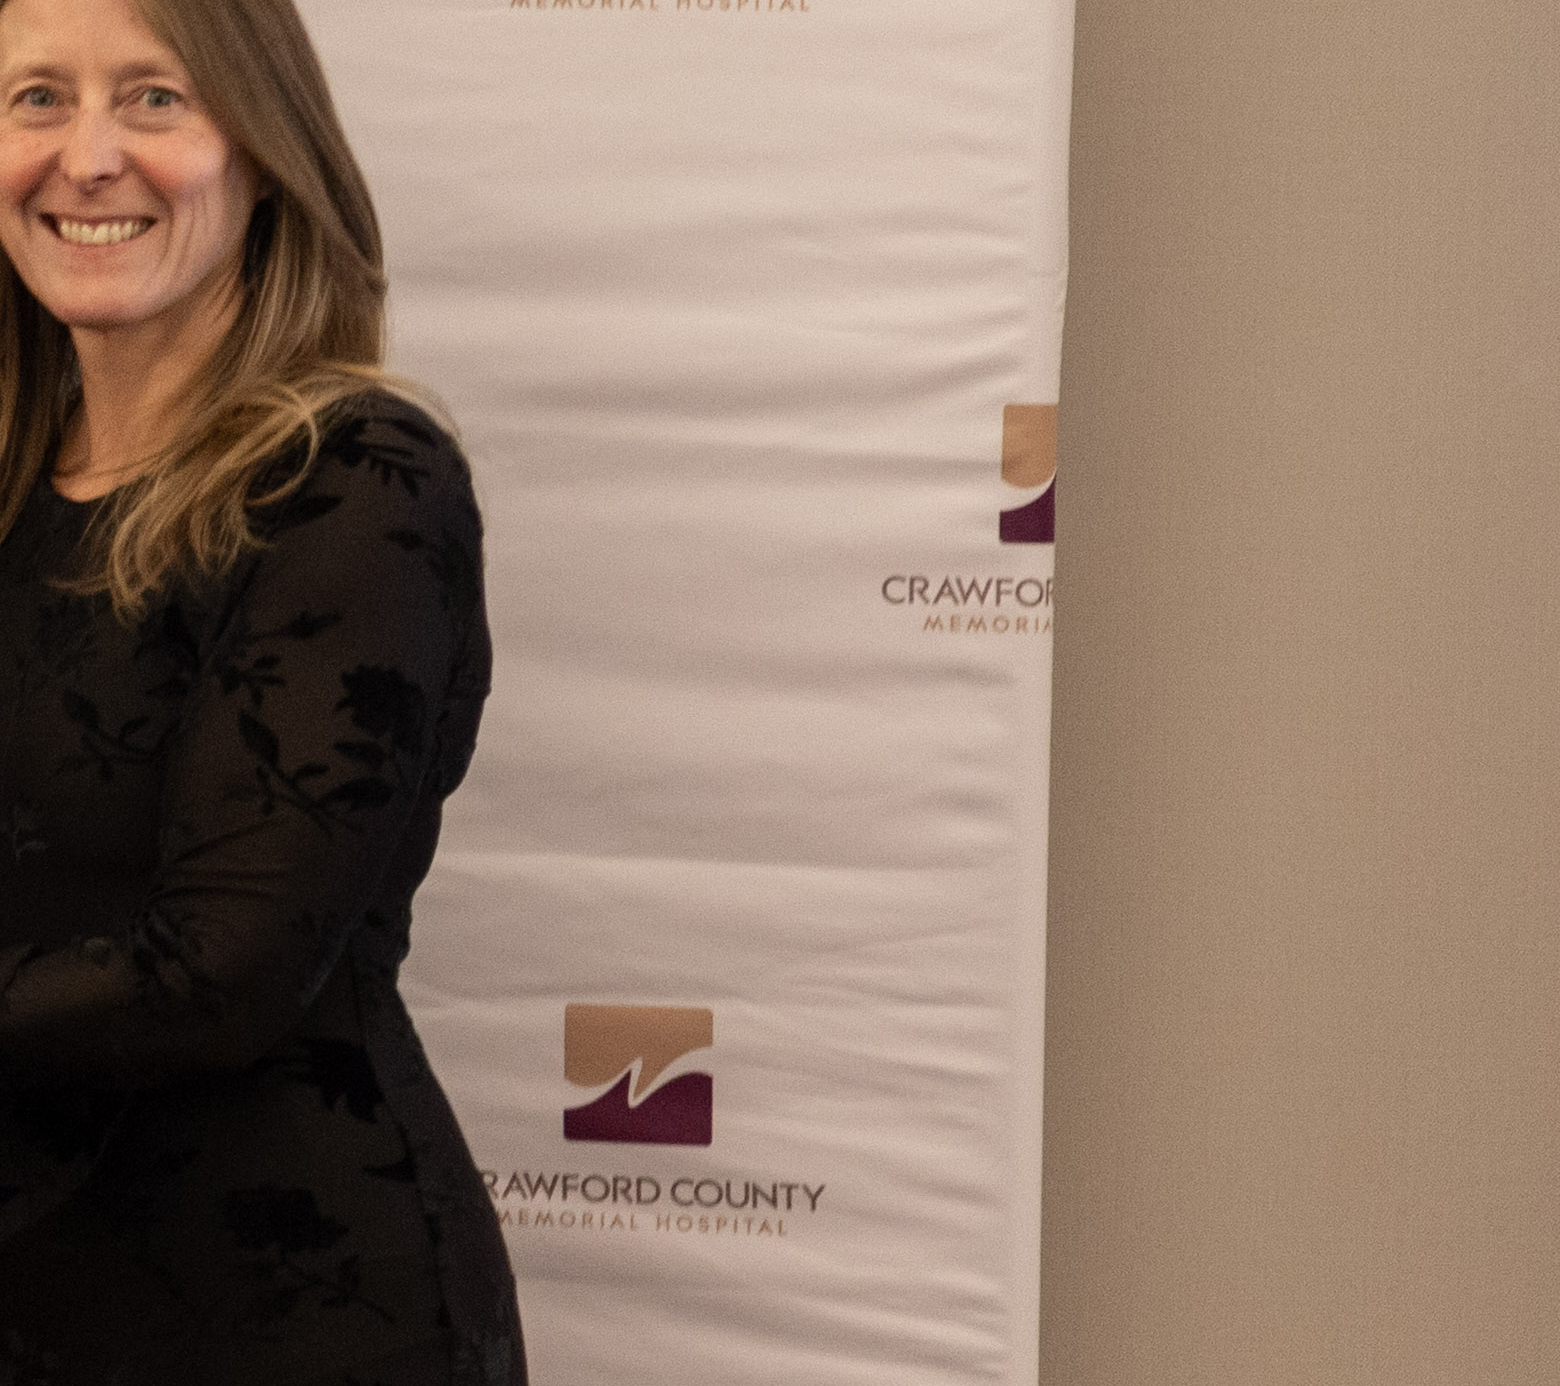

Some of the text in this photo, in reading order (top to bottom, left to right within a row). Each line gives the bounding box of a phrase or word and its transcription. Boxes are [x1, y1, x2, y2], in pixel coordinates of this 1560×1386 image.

[479, 1170, 825, 1212] RAWFORD COUNTY
[499, 1210, 789, 1238] MEMORIAL HOSPITAL
